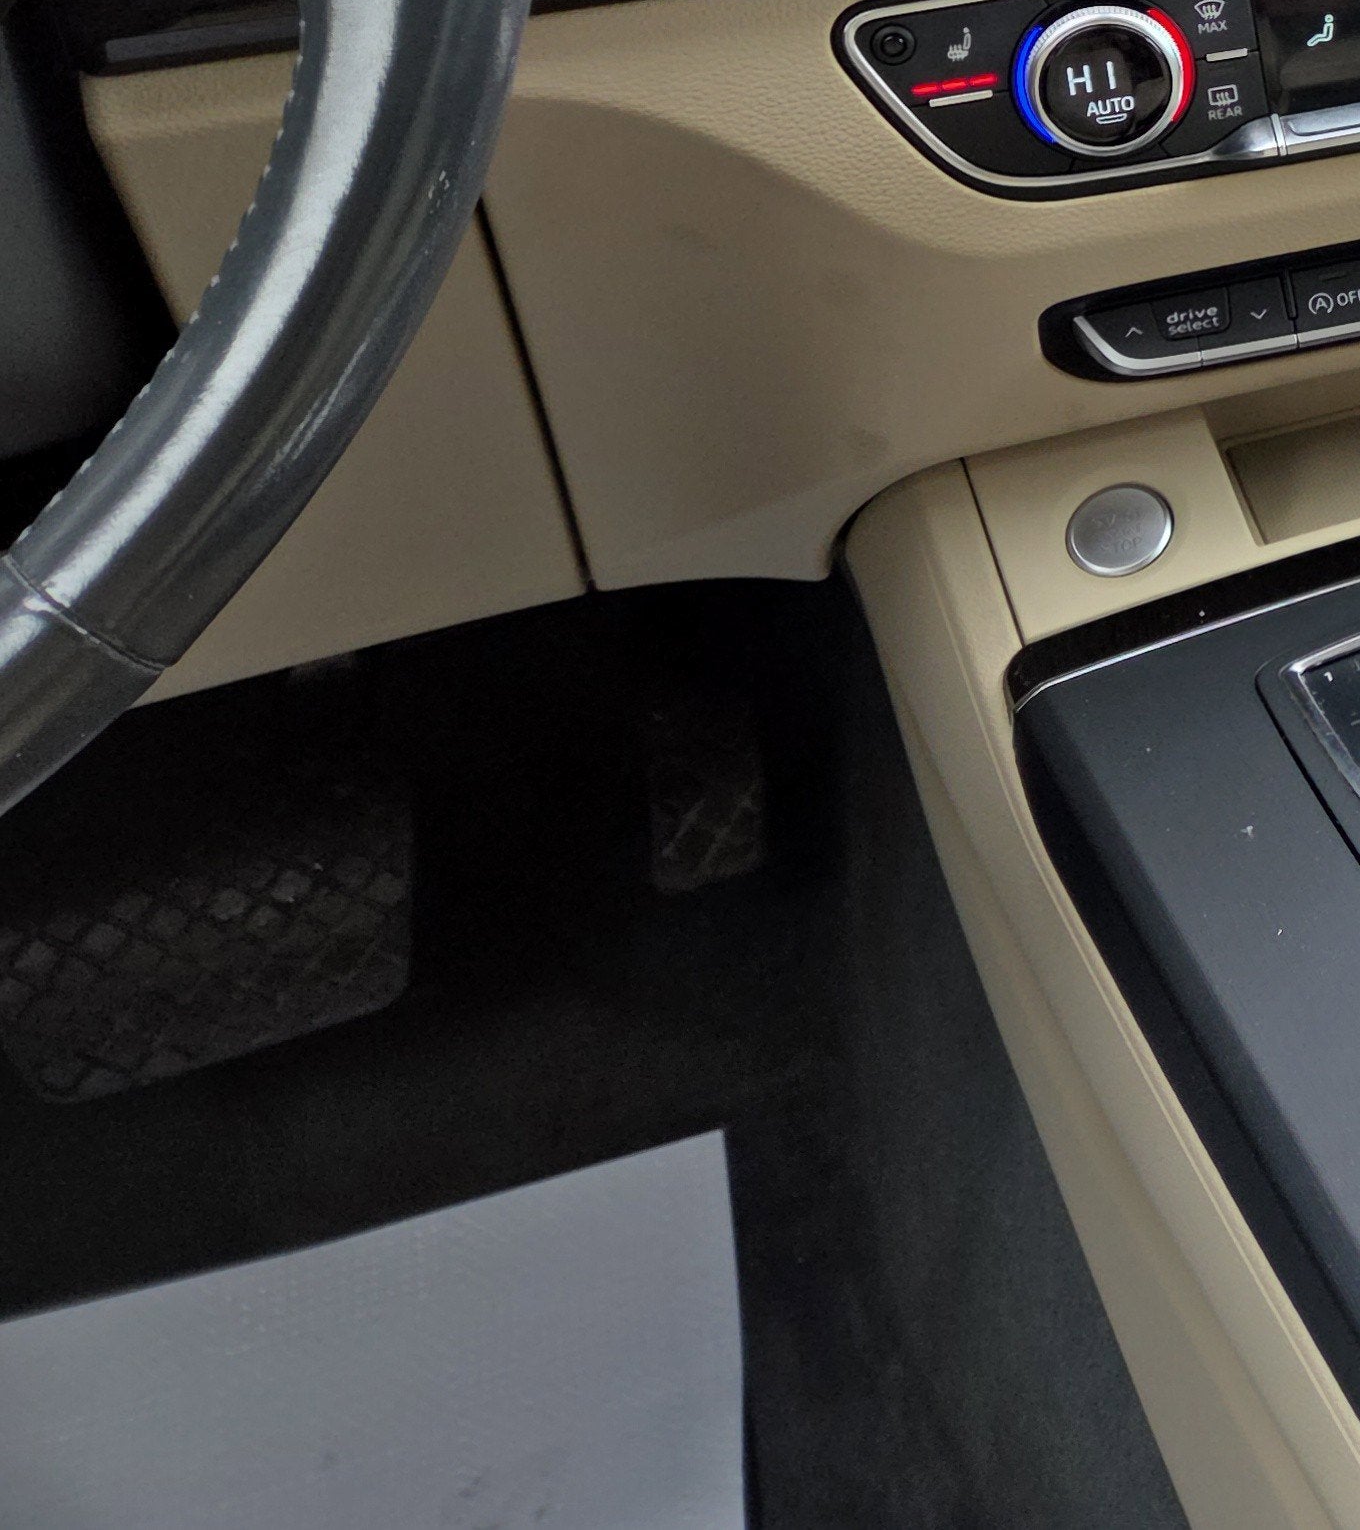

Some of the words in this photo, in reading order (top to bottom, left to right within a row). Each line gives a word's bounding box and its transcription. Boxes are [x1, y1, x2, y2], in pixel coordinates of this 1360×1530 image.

[1198, 20, 1228, 34] MAX
[1066, 60, 1117, 96] HI
[1087, 95, 1135, 117] AUTO
[1208, 106, 1243, 120] REAR
[1166, 305, 1218, 324] drive
[1168, 317, 1219, 336] select
[1323, 671, 1333, 682] 1
